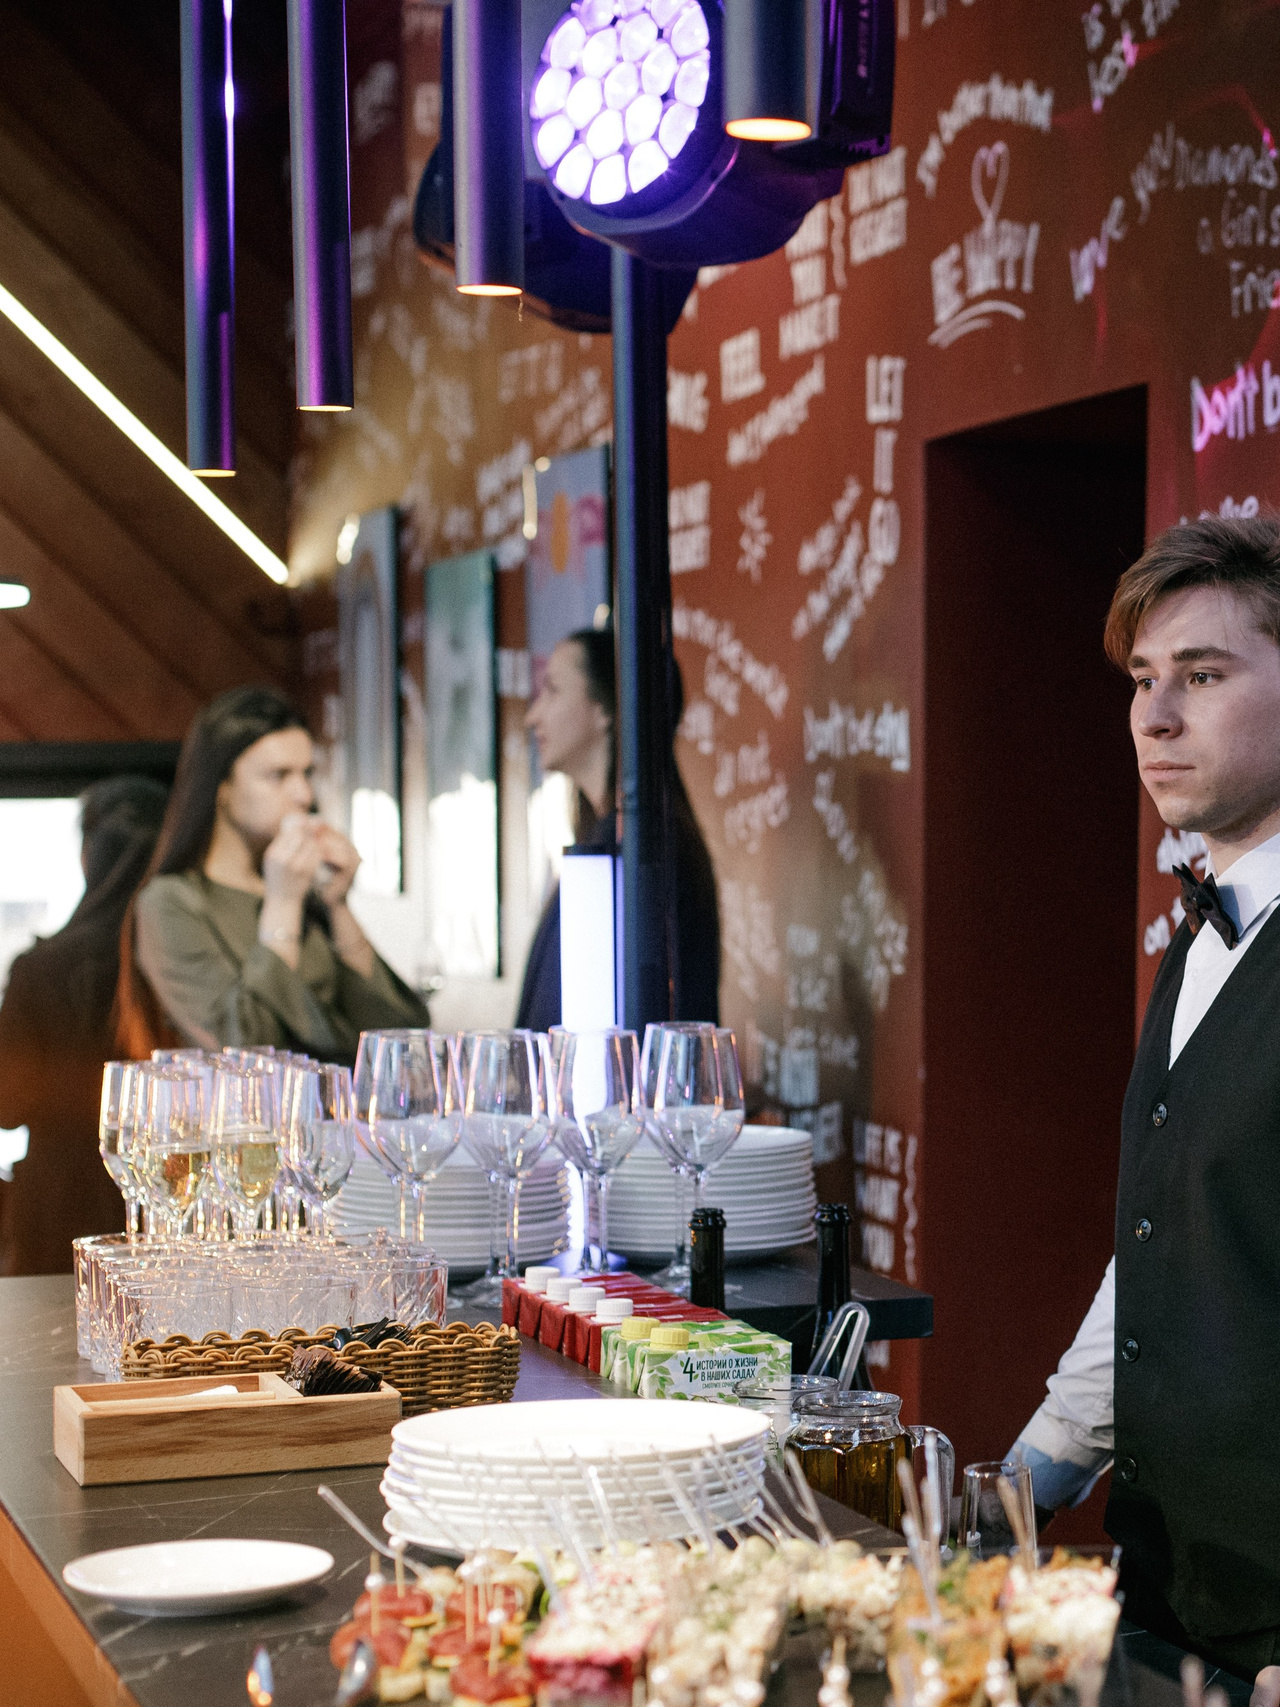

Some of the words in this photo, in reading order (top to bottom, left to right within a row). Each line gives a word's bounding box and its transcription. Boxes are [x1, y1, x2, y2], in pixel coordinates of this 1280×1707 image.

[682, 1357, 696, 1383] 4
[734, 1356, 759, 1368] ЖИЗНИ
[731, 1368, 757, 1380] САДАХ
